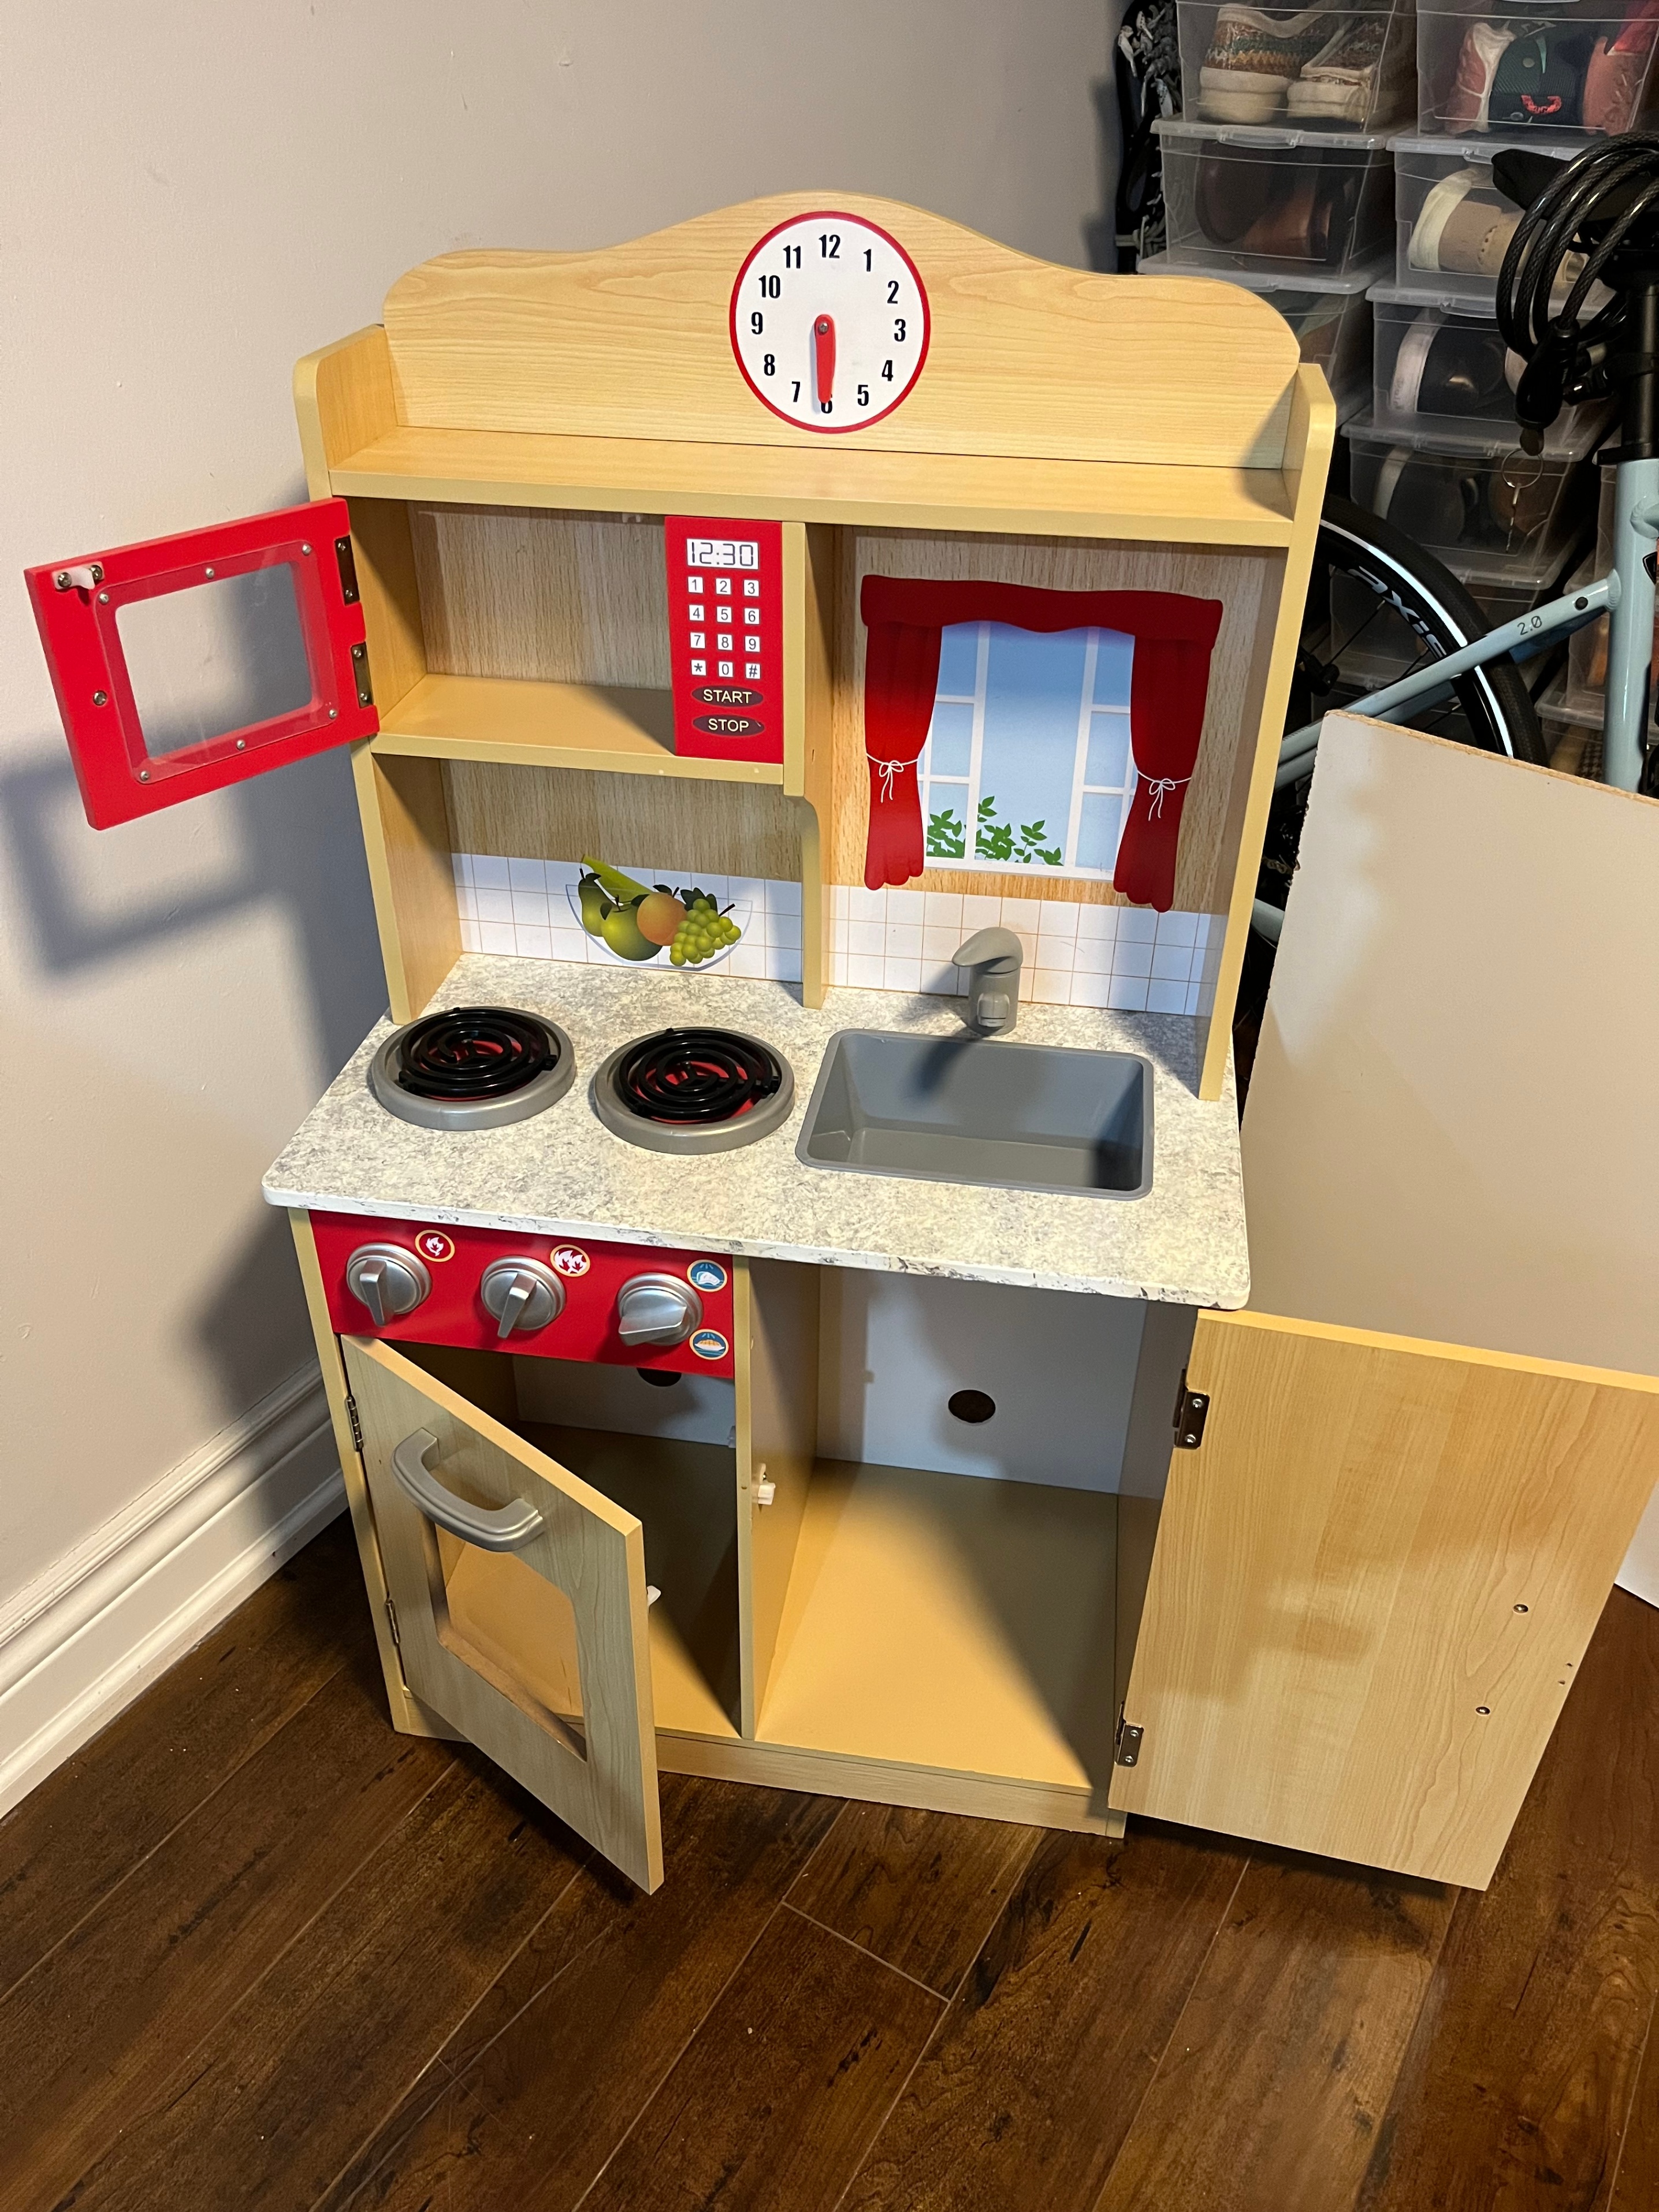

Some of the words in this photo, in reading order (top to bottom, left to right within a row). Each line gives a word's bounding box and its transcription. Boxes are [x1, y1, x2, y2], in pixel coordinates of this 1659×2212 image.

[783, 245, 801, 269] 11
[819, 234, 840, 259] 12
[863, 248, 872, 272] 1
[758, 275, 781, 299] 10
[887, 280, 899, 304] 2
[751, 311, 763, 335] 9
[894, 318, 906, 342] 3
[764, 353, 775, 377] 8
[881, 360, 894, 382] 4
[791, 381, 801, 403] 7
[857, 384, 869, 407] 5
[691, 542, 754, 567] 12:30
[691, 579, 697, 591] 1
[720, 580, 728, 593] 2
[747, 582, 755, 594] 3
[693, 608, 700, 619] 4
[721, 609, 728, 620] 5
[748, 610, 756, 622] 6
[1517, 616, 1542, 635] 2.0
[694, 635, 701, 646] 7
[721, 636, 729, 649] 8
[749, 638, 756, 650] 9
[721, 664, 729, 675] 0
[749, 665, 757, 677] #
[703, 688, 752, 703] START
[708, 718, 749, 732] STOP
